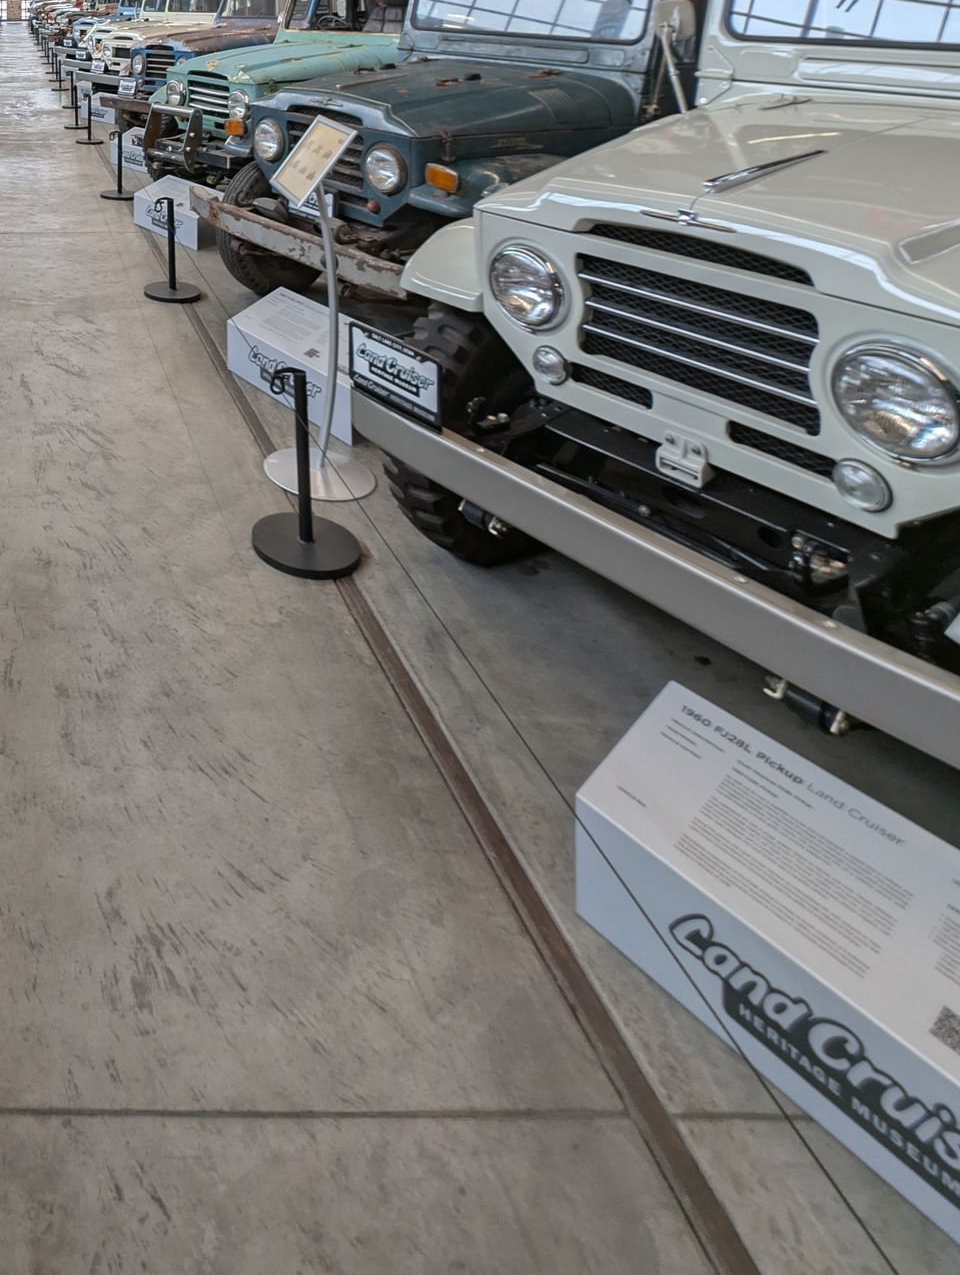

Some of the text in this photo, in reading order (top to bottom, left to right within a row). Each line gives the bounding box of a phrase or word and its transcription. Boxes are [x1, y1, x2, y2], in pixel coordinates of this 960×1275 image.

[356, 343, 387, 368] Land
[386, 357, 435, 390] Cruiser
[681, 705, 711, 727] 1960
[714, 725, 751, 753] FJ28L
[755, 751, 804, 785] Pickup
[807, 782, 845, 809] Land
[847, 808, 906, 845] Cruiser
[668, 912, 813, 1032] Land
[806, 1016, 960, 1171] Cruis
[738, 1002, 842, 1096] HERITAGE
